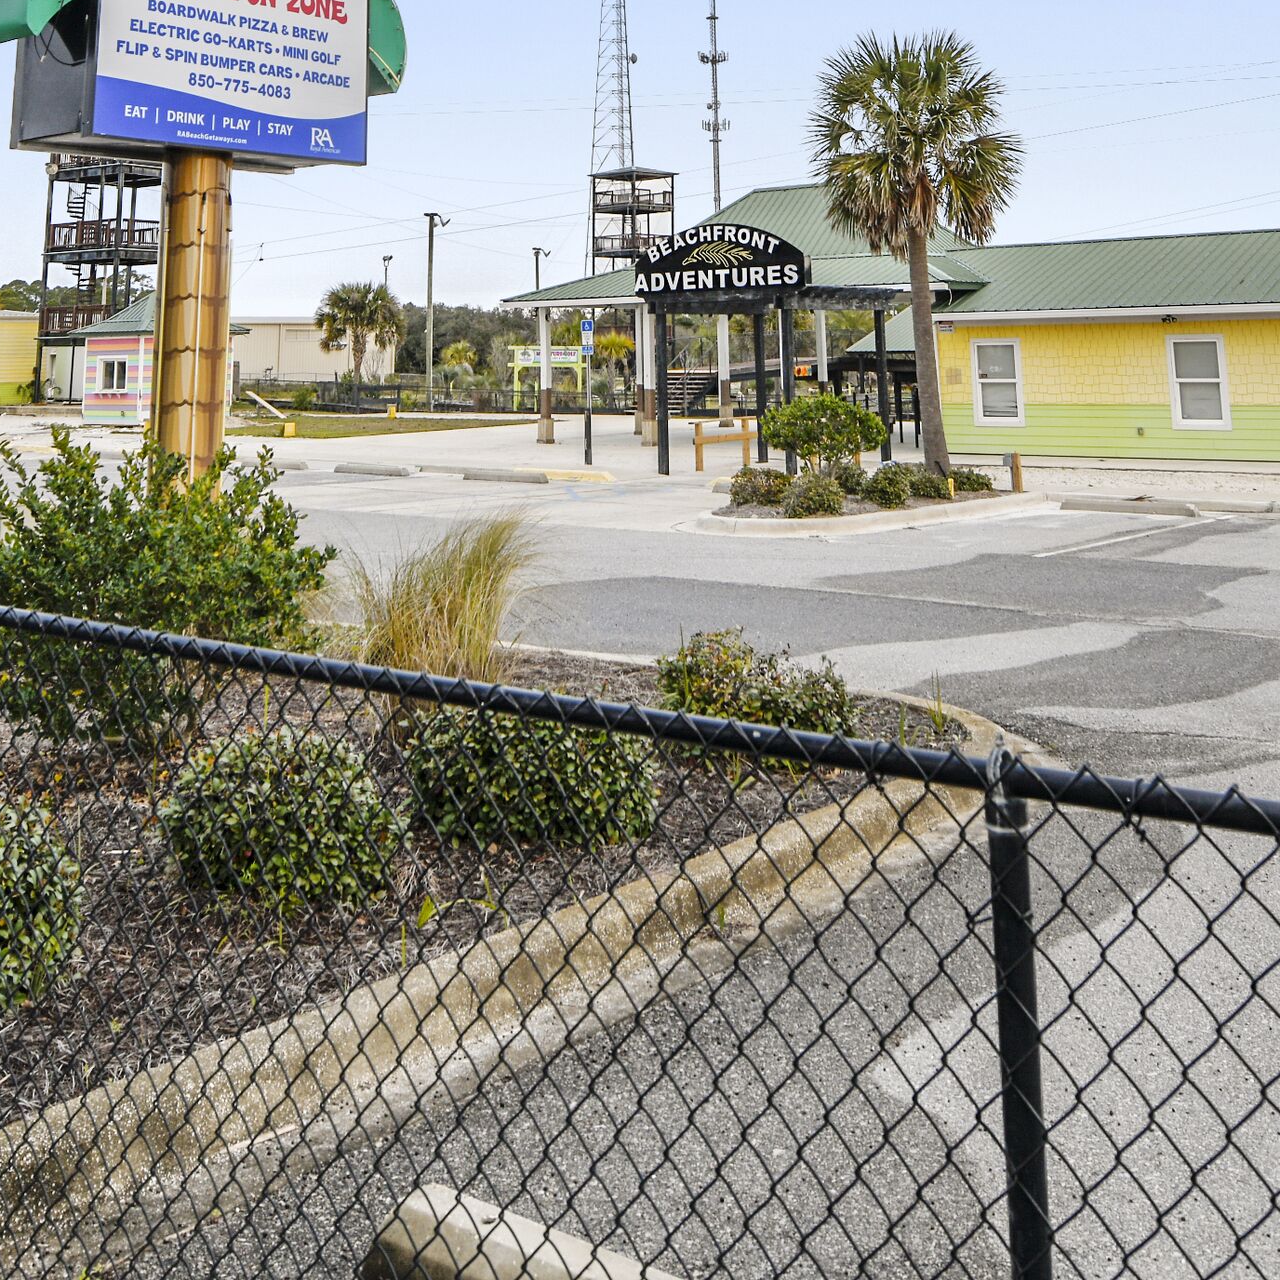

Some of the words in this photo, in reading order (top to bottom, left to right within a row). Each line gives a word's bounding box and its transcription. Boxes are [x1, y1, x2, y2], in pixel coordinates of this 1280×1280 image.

[129, 19, 200, 43] ELECTRIC
[203, 32, 273, 55] GO-KARTS
[282, 45, 309, 61] MINI
[311, 50, 342, 66] GOLF
[239, 16, 278, 35] PIZZA
[281, 24, 290, 36] &
[292, 25, 329, 43] BREW
[116, 39, 149, 57] FLIP
[152, 46, 162, 59] &
[165, 47, 198, 65] SPIN
[200, 54, 256, 75] BUMPER
[258, 63, 294, 80] CARS
[302, 70, 351, 89] ARCADE
[188, 72, 292, 100] 850-775-4083
[124, 104, 149, 119] EAT
[166, 109, 206, 126] DRINK
[222, 116, 251, 132] PLAY
[267, 122, 294, 136] STAY
[176, 130, 249, 145] RABeachGetaways.com
[310, 126, 335, 148] RA
[646, 225, 780, 263] BEACHFRONT
[633, 263, 799, 293] ADVENTURES
